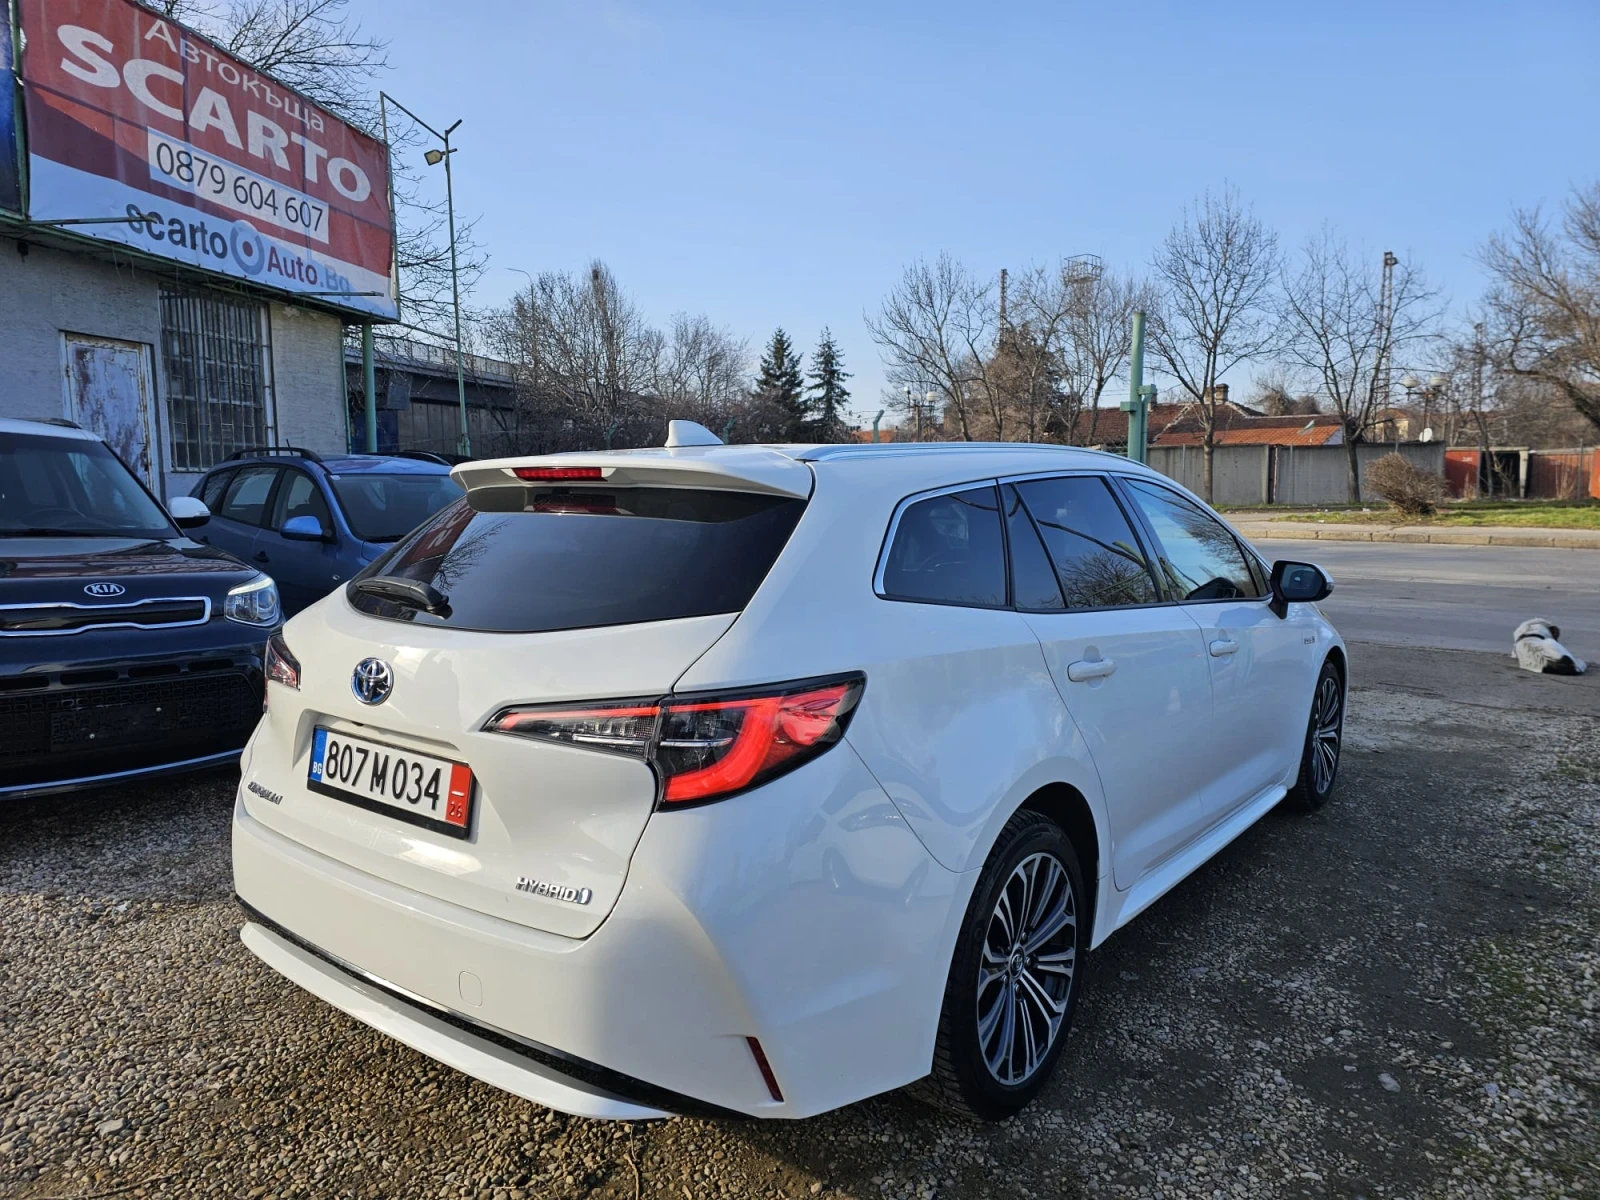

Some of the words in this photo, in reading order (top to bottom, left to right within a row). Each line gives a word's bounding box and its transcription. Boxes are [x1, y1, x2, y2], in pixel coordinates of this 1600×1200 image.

[57, 24, 371, 202] SCARTO
[156, 142, 227, 195] 0879
[233, 175, 279, 216] 604
[284, 197, 324, 232] 607
[91, 583, 120, 594] KIA
[312, 761, 323, 775] BG
[326, 740, 369, 787] 807
[370, 751, 389, 795] M
[392, 758, 442, 811] 034
[449, 800, 463, 819] 26
[516, 876, 577, 903] HYBRID
